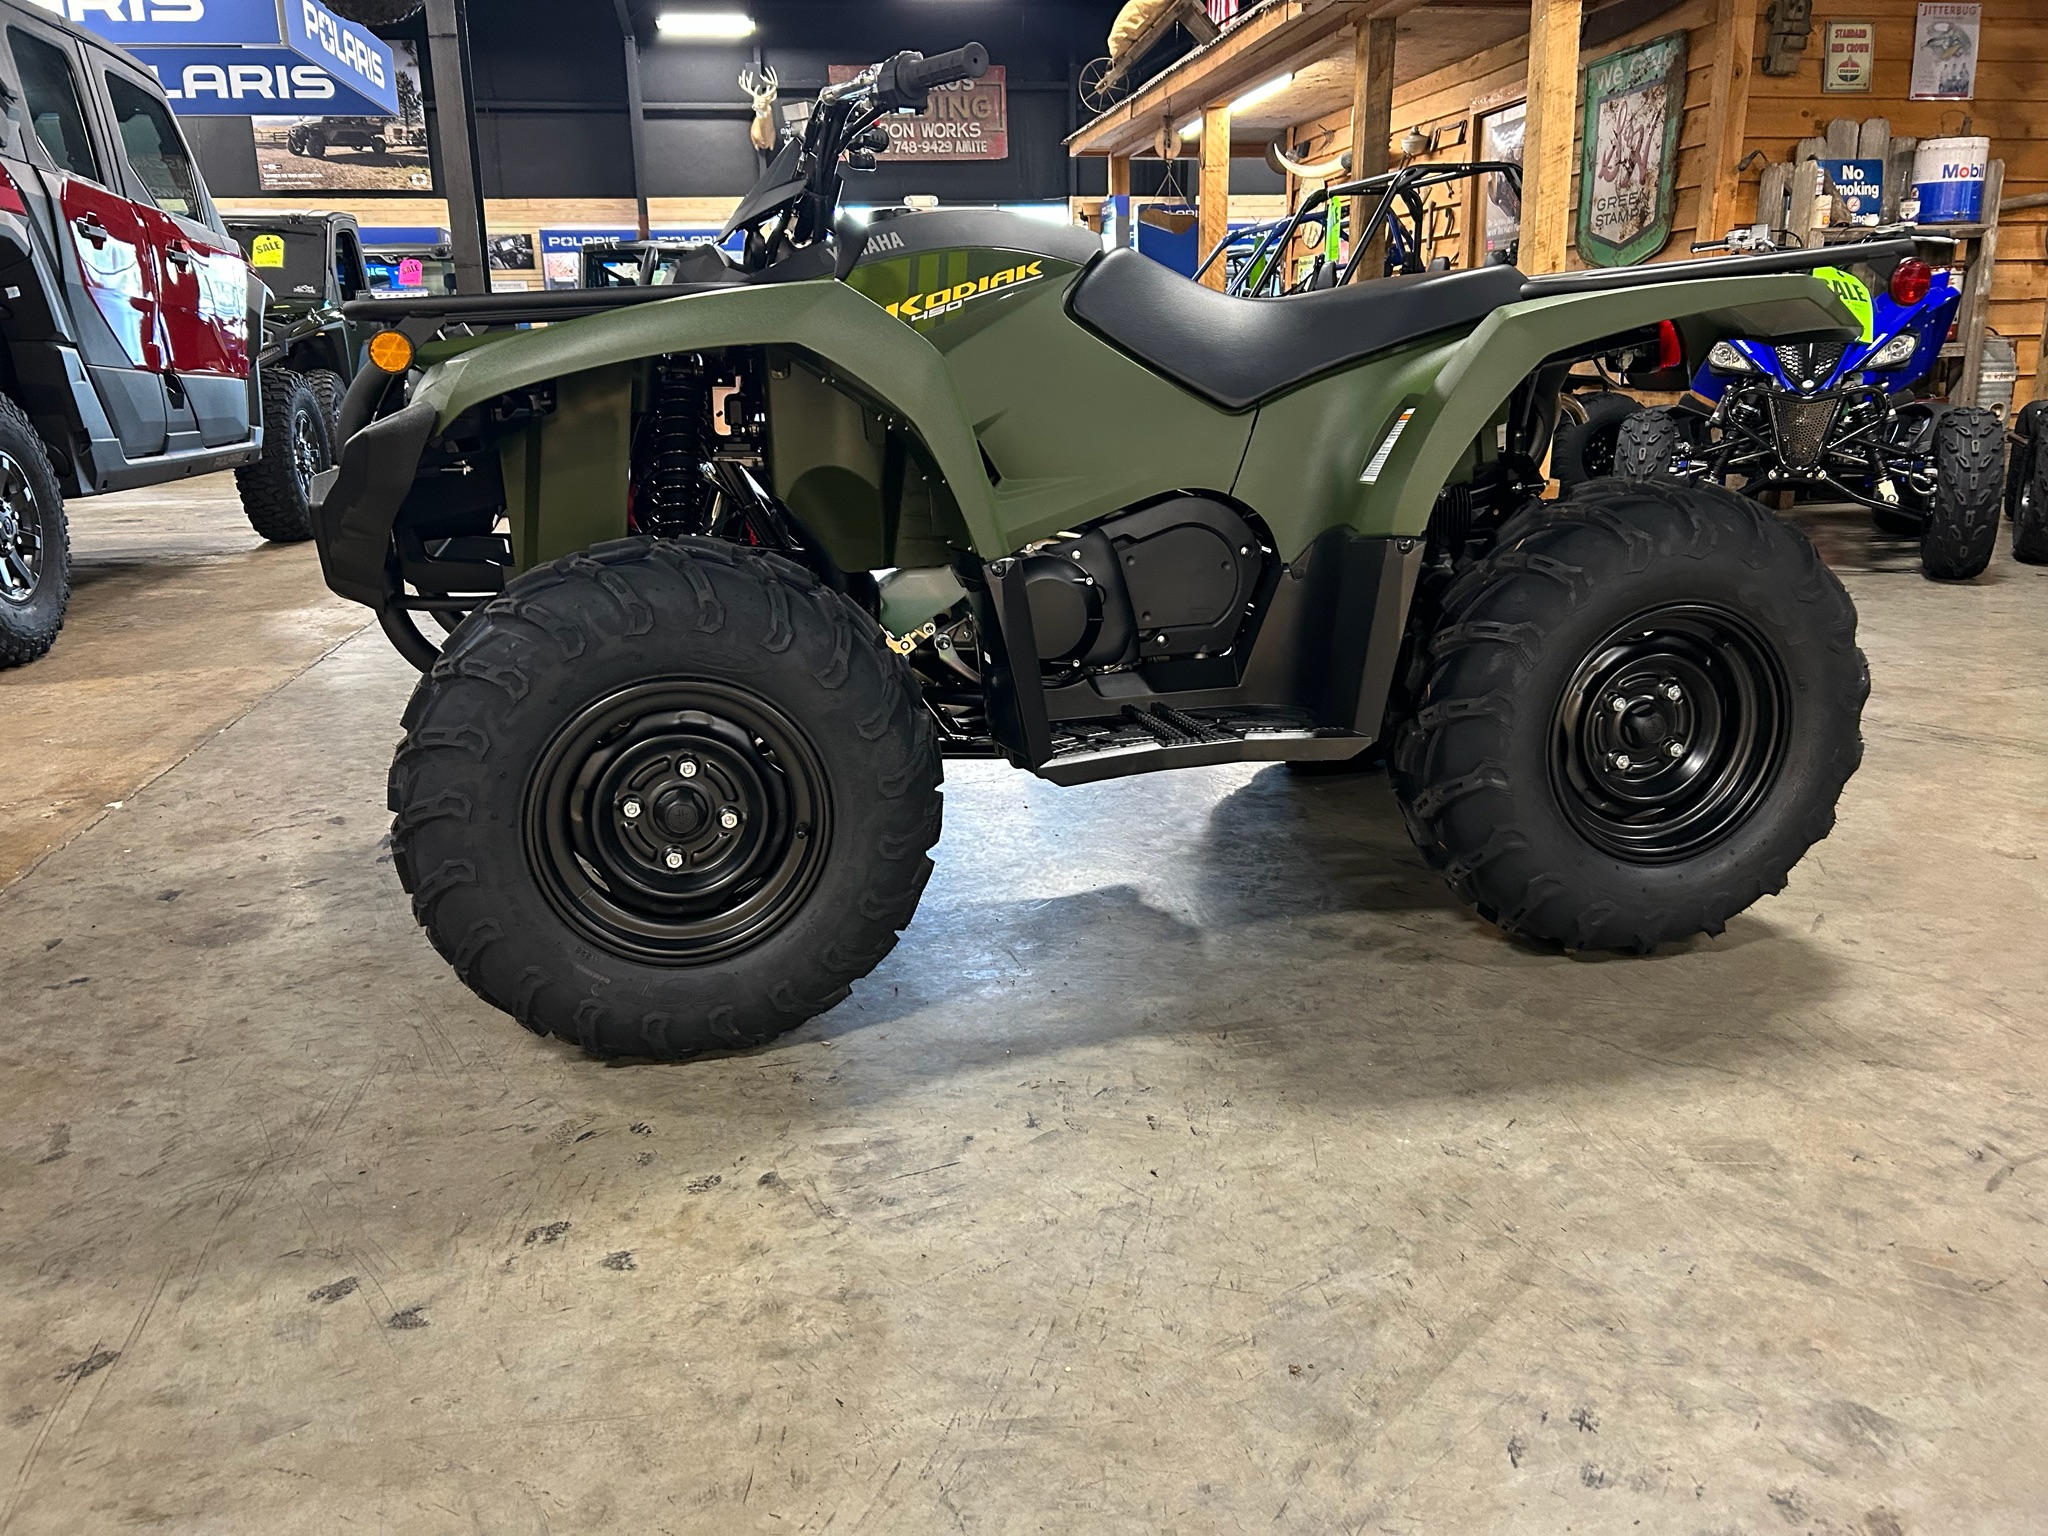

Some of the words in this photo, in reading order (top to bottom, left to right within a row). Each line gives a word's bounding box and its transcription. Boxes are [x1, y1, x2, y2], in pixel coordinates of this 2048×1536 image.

[1922, 5, 1978, 16] JITTERBUG
[304, 3, 386, 90] POLARIS
[920, 122, 982, 138] WORKS
[895, 141, 953, 153] 748-9429
[956, 140, 988, 153] AMITE
[1842, 165, 1864, 180] No
[1942, 163, 1985, 179] Mobil
[1833, 181, 1880, 198] moking
[1596, 188, 1651, 212] GREEN
[1595, 205, 1652, 228] STAMP
[256, 241, 282, 254] SALE
[825, 231, 905, 262] YAHA
[401, 264, 420, 275] SALE
[885, 260, 1043, 318] KODIAK
[910, 299, 963, 323] 450
